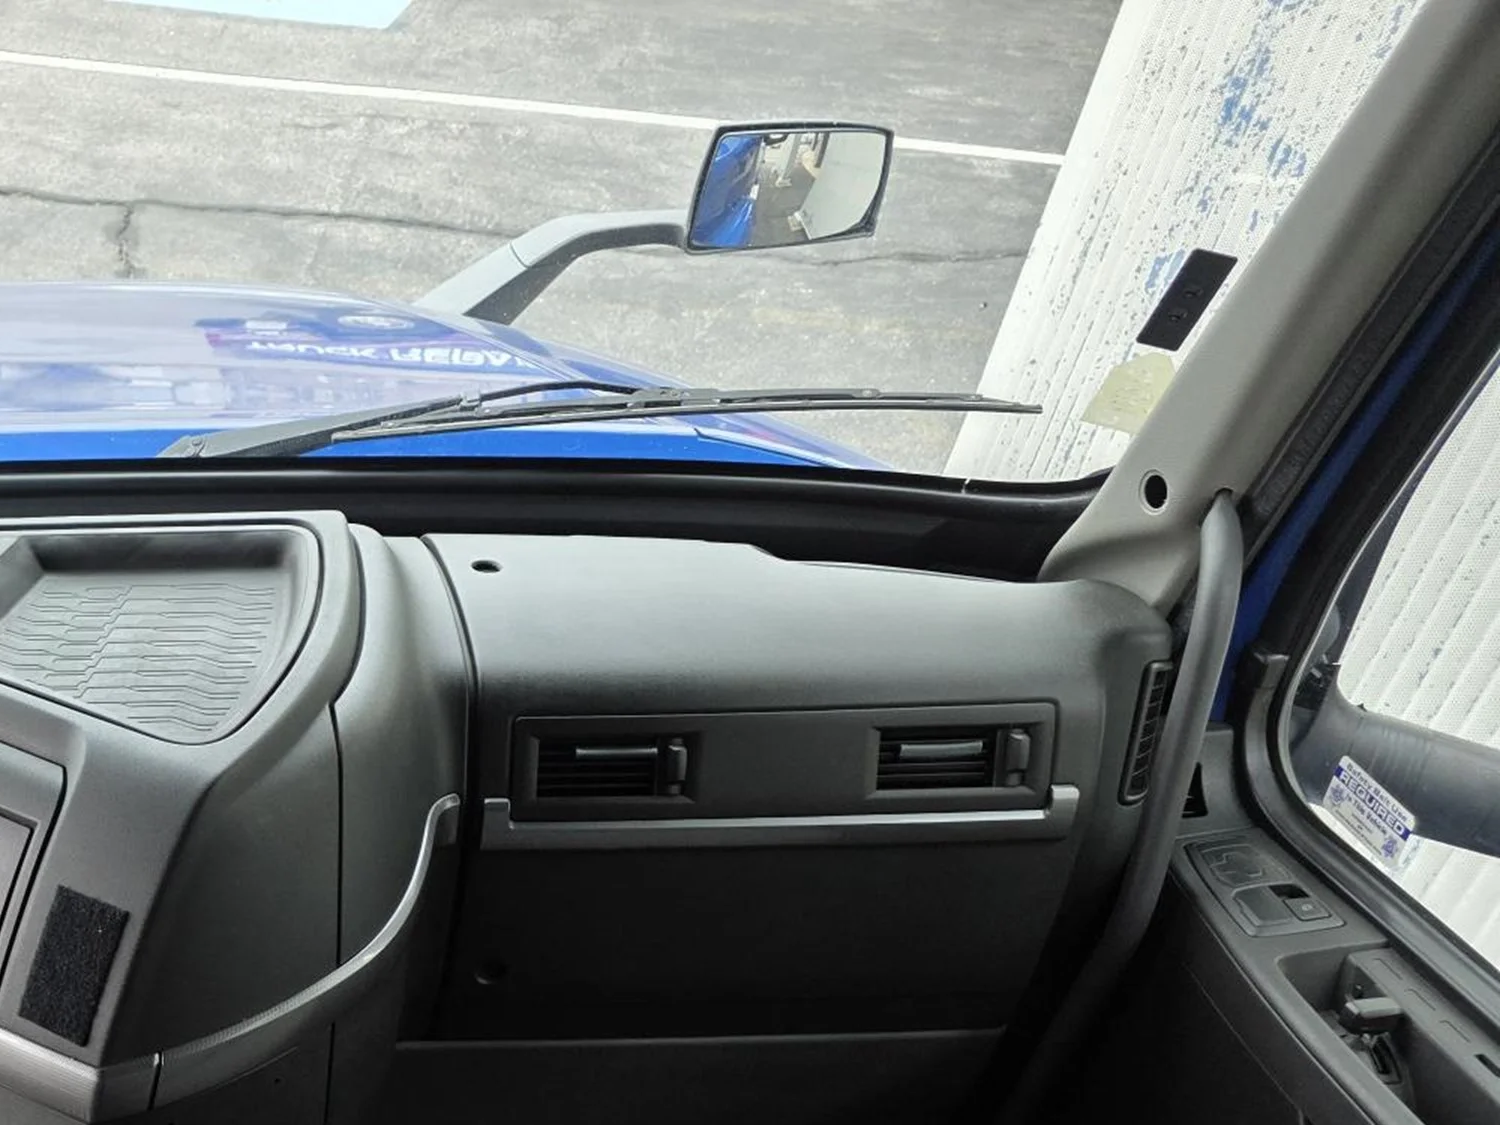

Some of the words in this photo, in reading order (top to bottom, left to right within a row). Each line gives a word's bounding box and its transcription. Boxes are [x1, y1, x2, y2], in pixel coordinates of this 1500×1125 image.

[1340, 771, 1405, 836] REQUIRED
[1347, 763, 1372, 789] Safety
[1391, 803, 1407, 822] Use
